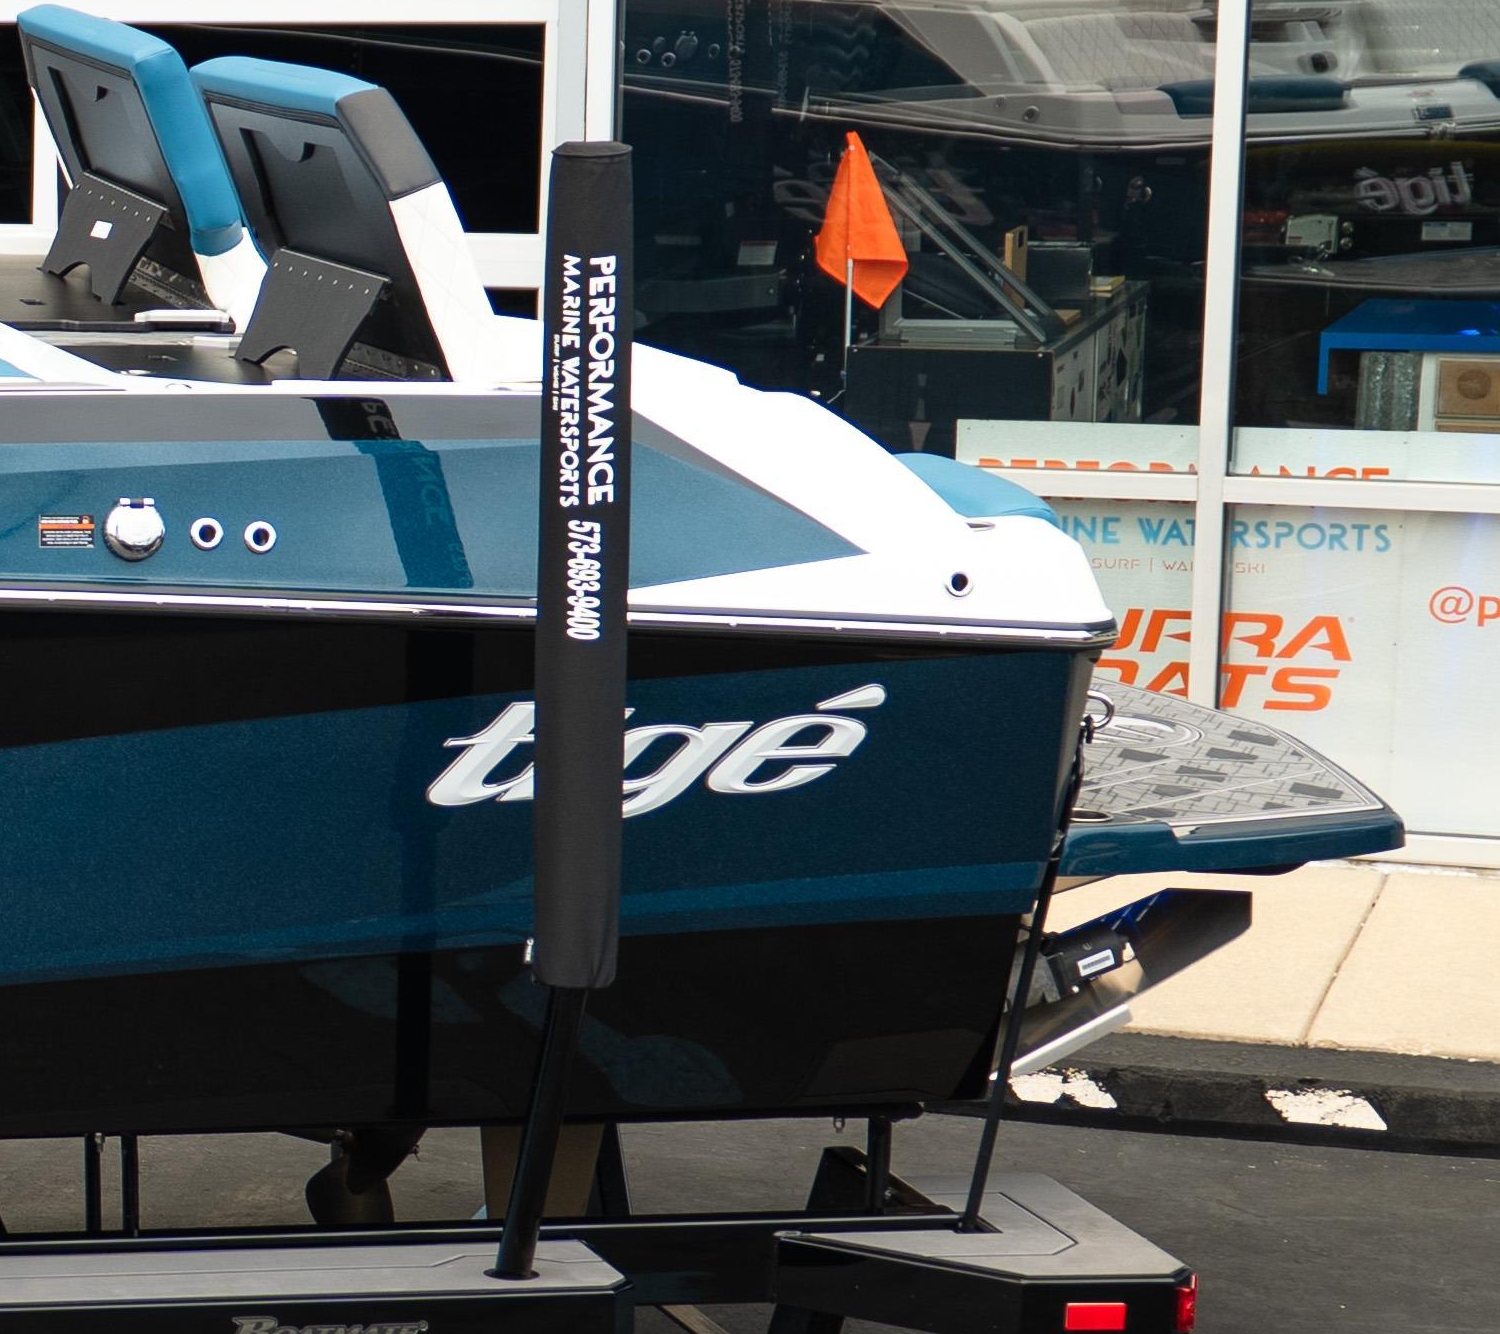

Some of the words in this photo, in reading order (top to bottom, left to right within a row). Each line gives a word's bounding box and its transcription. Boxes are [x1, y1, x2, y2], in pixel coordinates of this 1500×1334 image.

[562, 254, 582, 349] MARINE
[559, 356, 581, 508] WATERSPORTS
[586, 254, 617, 506] PERFORMANCE
[566, 519, 601, 641] 573-693-9400
[1091, 557, 1141, 570] SURF
[1234, 562, 1267, 575] SKI
[1137, 517, 1392, 553] WATRSPORTS
[425, 683, 888, 819] tgé
